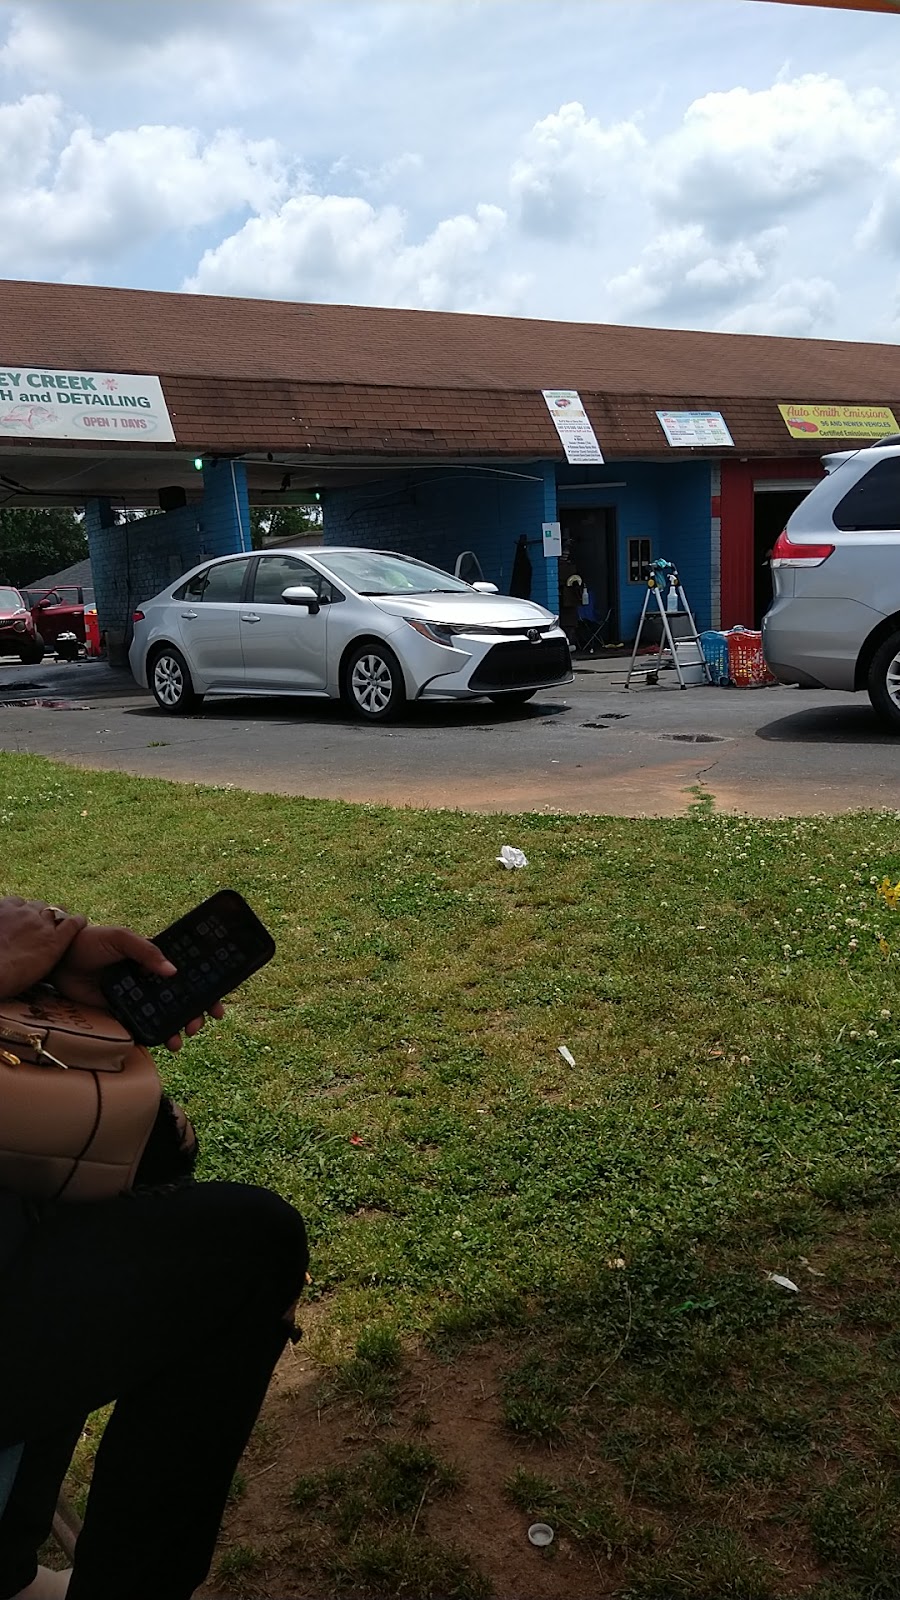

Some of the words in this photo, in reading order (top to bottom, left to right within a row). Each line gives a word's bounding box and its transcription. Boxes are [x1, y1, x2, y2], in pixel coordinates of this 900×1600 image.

[26, 373, 98, 391] CREEK
[19, 391, 52, 403] and
[56, 392, 151, 409] DETAILING
[787, 406, 809, 417] Auto
[812, 406, 840, 417] Smith
[843, 407, 889, 418] Emissions
[83, 416, 110, 428] OPEN
[111, 417, 117, 428] 7
[120, 418, 148, 429] DAYS
[819, 429, 844, 437] Certified
